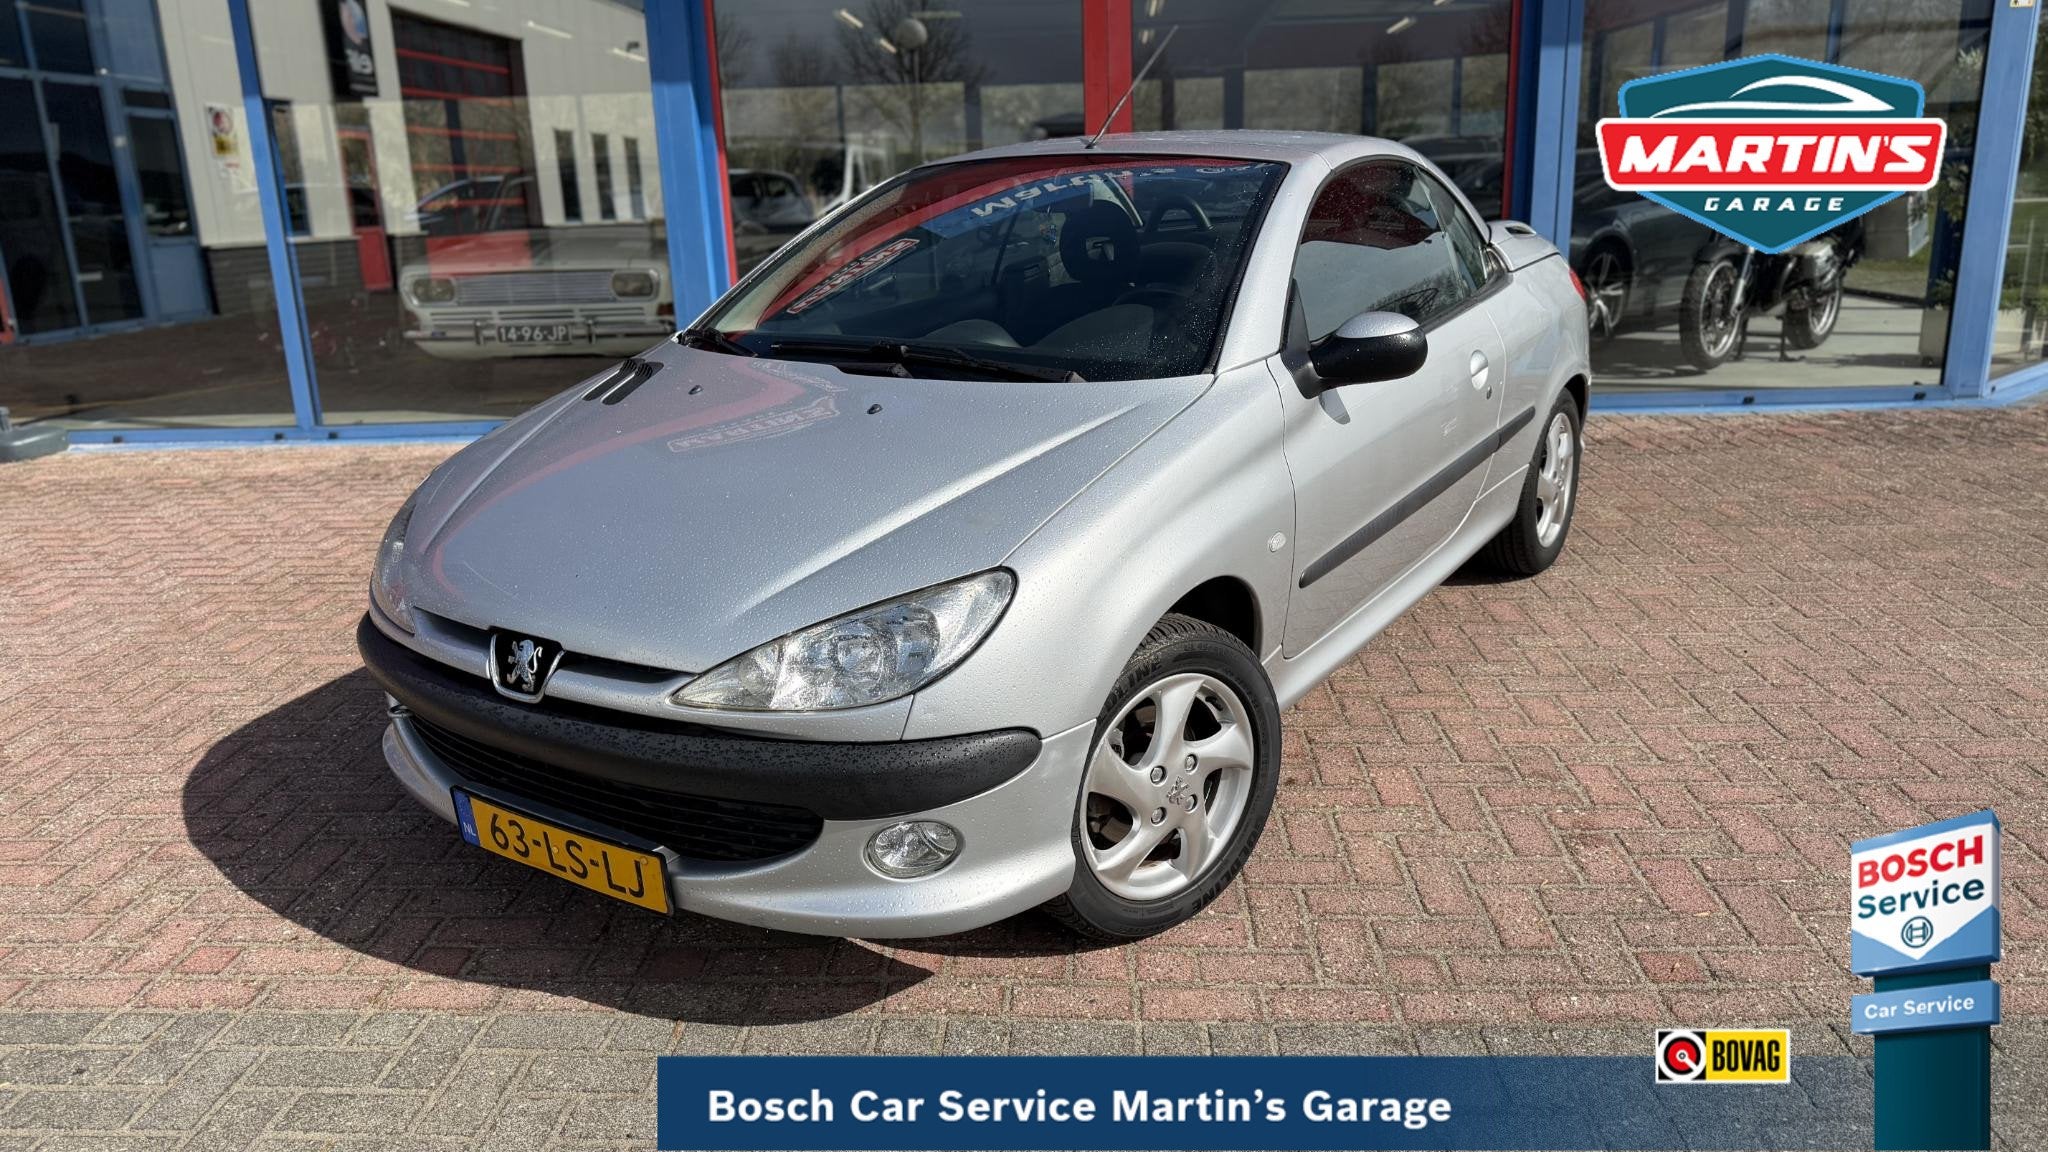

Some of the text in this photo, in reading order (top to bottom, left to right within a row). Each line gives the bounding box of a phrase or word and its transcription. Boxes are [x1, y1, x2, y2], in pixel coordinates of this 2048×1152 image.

[500, 326, 567, 341] 14-96-JP
[462, 822, 477, 837] NL
[490, 813, 645, 898] 63-LS-LJ
